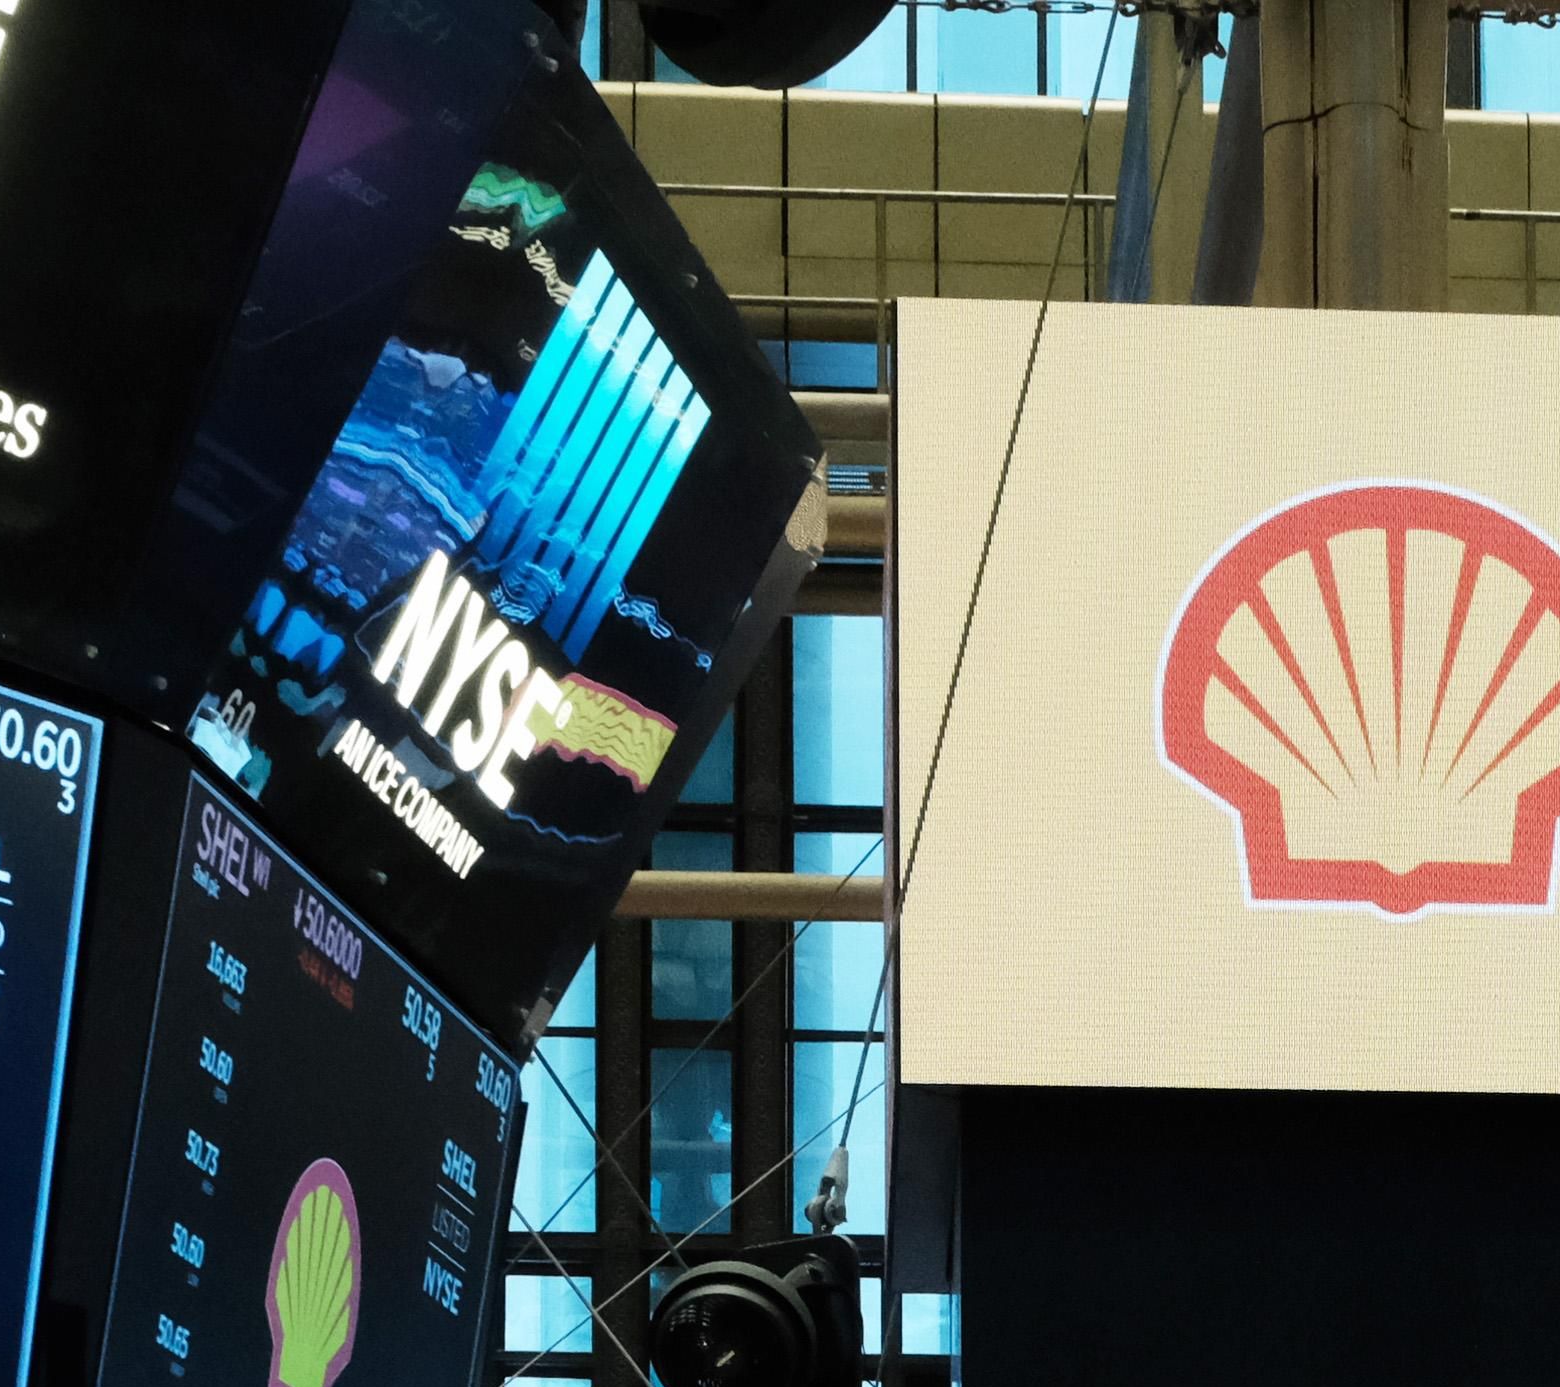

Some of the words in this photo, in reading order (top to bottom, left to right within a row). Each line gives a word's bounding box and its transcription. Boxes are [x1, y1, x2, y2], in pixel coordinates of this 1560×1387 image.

[369, 546, 562, 812] NYSE
[57, 778, 78, 816] 3
[333, 720, 376, 774] AN
[362, 744, 407, 804] ICE
[393, 776, 485, 879] COMPANY
[196, 802, 251, 898] SHEL
[442, 1138, 479, 1199] SHEL
[423, 1256, 464, 1317] NYSE
